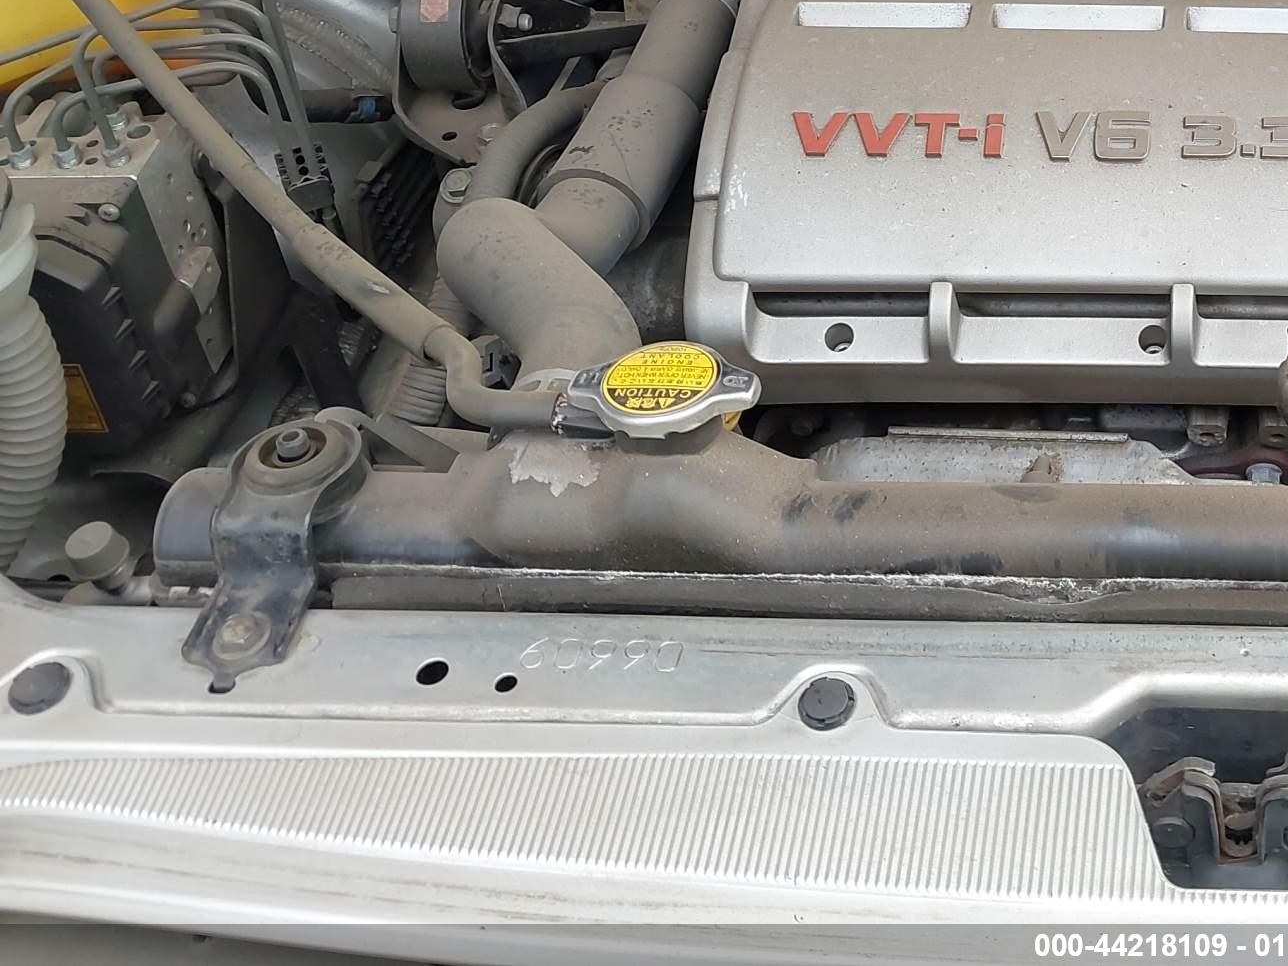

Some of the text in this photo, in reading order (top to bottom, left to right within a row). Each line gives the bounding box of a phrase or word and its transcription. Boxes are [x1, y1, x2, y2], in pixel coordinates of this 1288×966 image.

[791, 111, 1007, 159] VVT-i
[1034, 110, 1152, 162] V6
[640, 353, 701, 361] COOLANT
[614, 387, 692, 399] CAUTION
